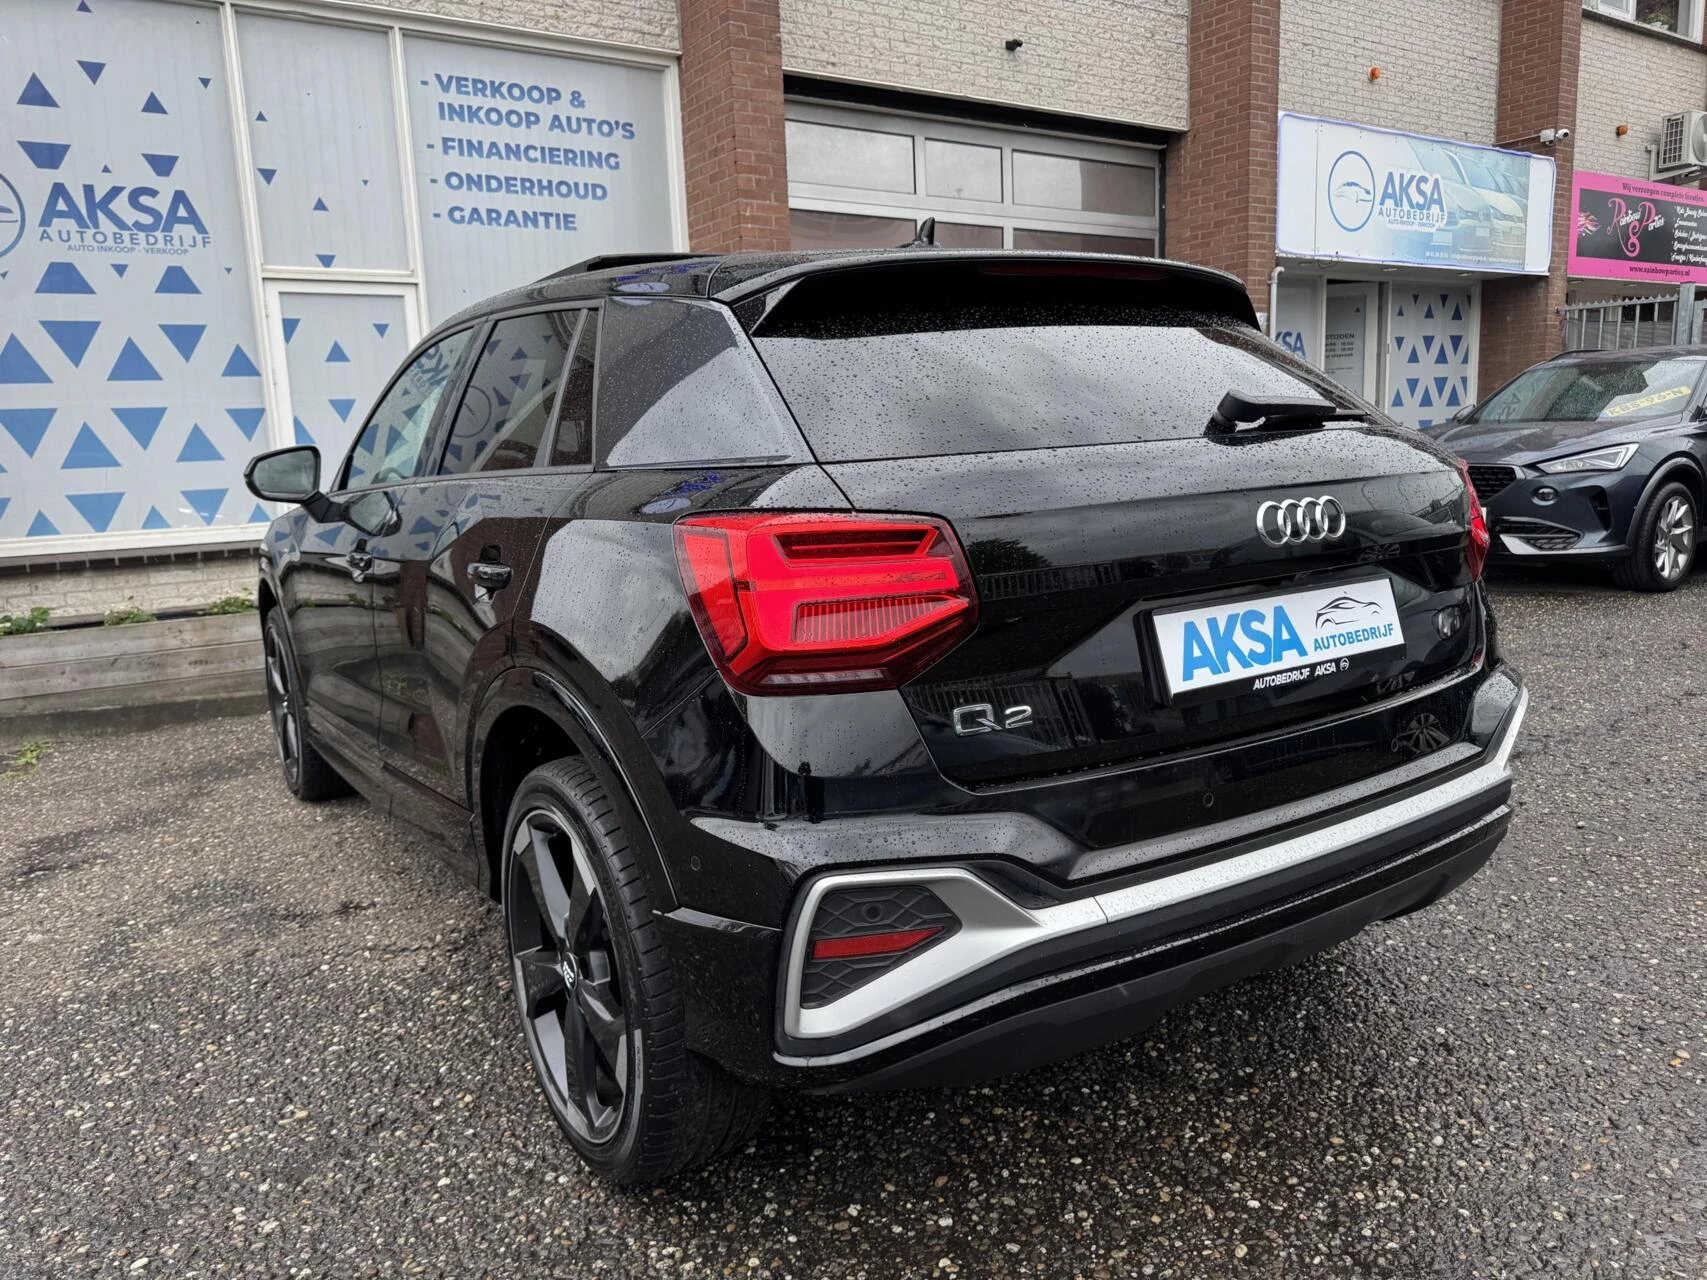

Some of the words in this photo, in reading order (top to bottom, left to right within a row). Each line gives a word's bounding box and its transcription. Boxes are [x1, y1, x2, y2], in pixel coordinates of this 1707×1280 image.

[434, 73, 562, 105] VERKOOP
[569, 90, 586, 108] &
[438, 101, 541, 129] INKOOP
[442, 136, 620, 170] FINANCIERING
[445, 171, 608, 201] ONDERHOUD
[1379, 171, 1445, 213] AKSA
[38, 182, 209, 235] AKSA
[447, 206, 578, 231] GARANTIE
[1378, 207, 1446, 223] AUTOBEDRIJF
[39, 229, 212, 249] AUTOBEDRIJF
[67, 244, 95, 253] AUTO
[97, 245, 137, 254] INKOOP
[143, 247, 190, 256] VERKOOP
[1182, 605, 1309, 682] AKSA
[1313, 623, 1395, 653] AUTOBEDRIJF
[1252, 667, 1311, 691] AUTOBEDRIJF
[1314, 660, 1337, 678] AKSA
[953, 703, 1032, 736] Q2
